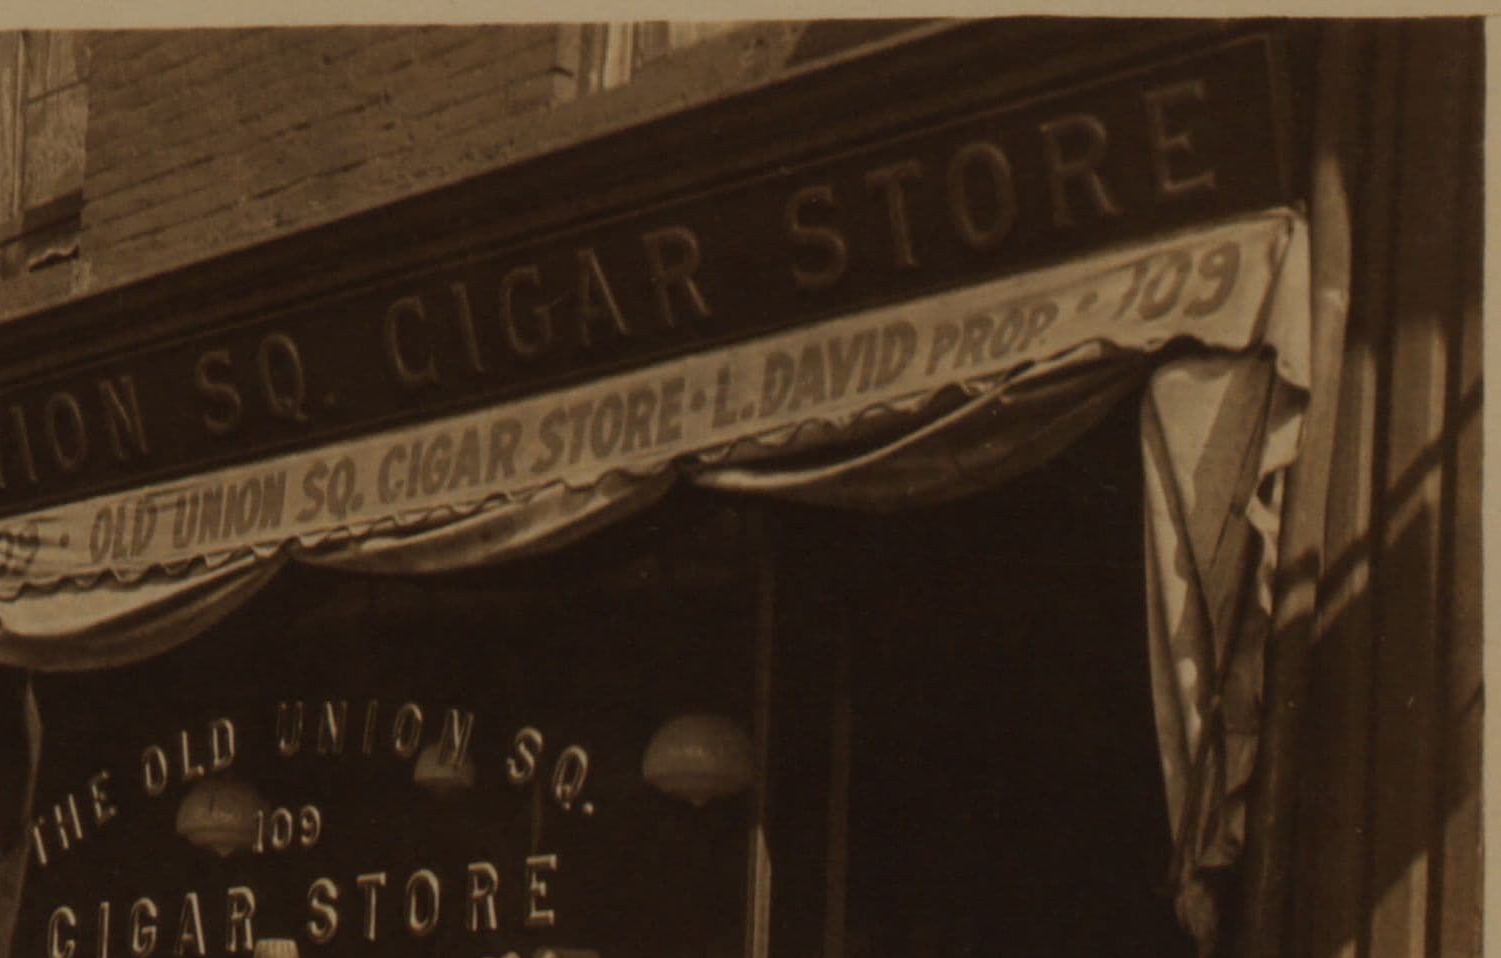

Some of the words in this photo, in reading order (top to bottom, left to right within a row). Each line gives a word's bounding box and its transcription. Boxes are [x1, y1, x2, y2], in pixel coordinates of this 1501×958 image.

[194, 332, 340, 437] SQ.
[384, 224, 714, 385] CIGAR
[783, 78, 1219, 290] STORE
[89, 497, 158, 565] OLD
[170, 471, 287, 544] UNION
[376, 415, 525, 505] CIGAR
[529, 376, 684, 476] STORE
[762, 319, 920, 404] DAVID
[1111, 241, 1242, 322] 109
[31, 770, 119, 870] THE
[140, 716, 239, 798] OLD
[274, 699, 477, 771] UNION
[505, 725, 596, 818] SQ.
[251, 803, 325, 856] 109
[305, 852, 560, 946] STORE
